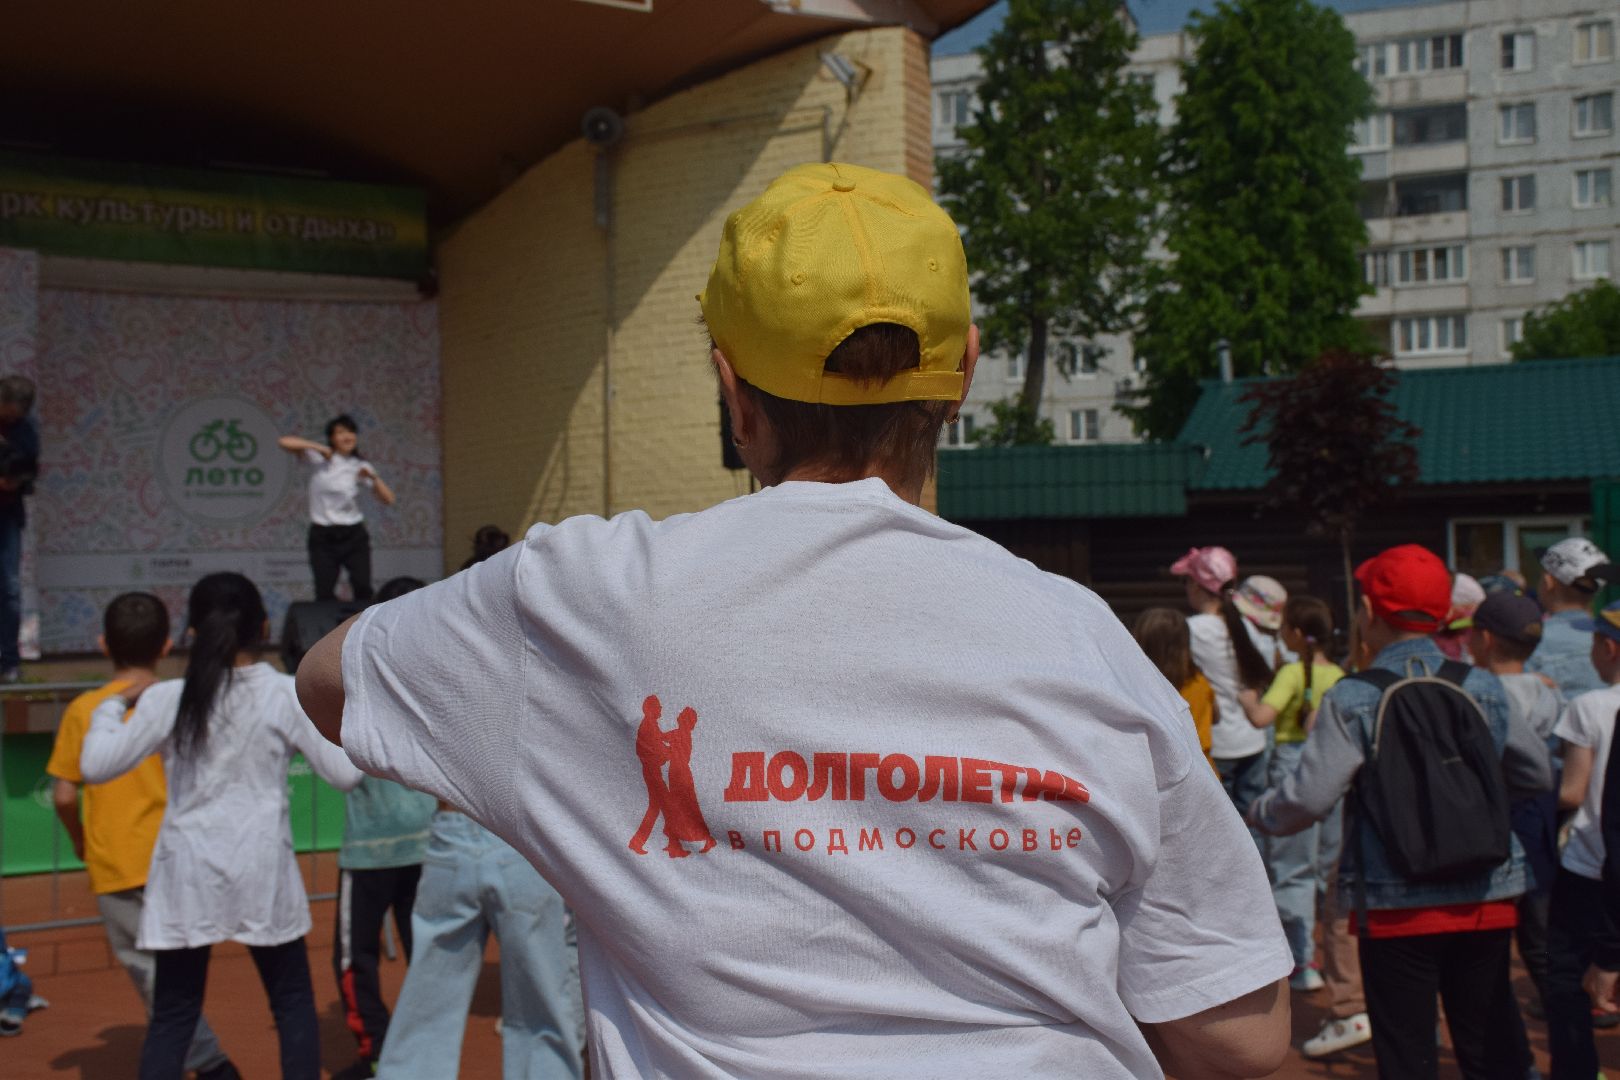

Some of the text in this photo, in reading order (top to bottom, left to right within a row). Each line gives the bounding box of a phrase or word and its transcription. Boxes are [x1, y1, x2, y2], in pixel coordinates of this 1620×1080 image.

[56, 194, 225, 234] культуры
[236, 208, 253, 232] и
[184, 467, 265, 486] лето
